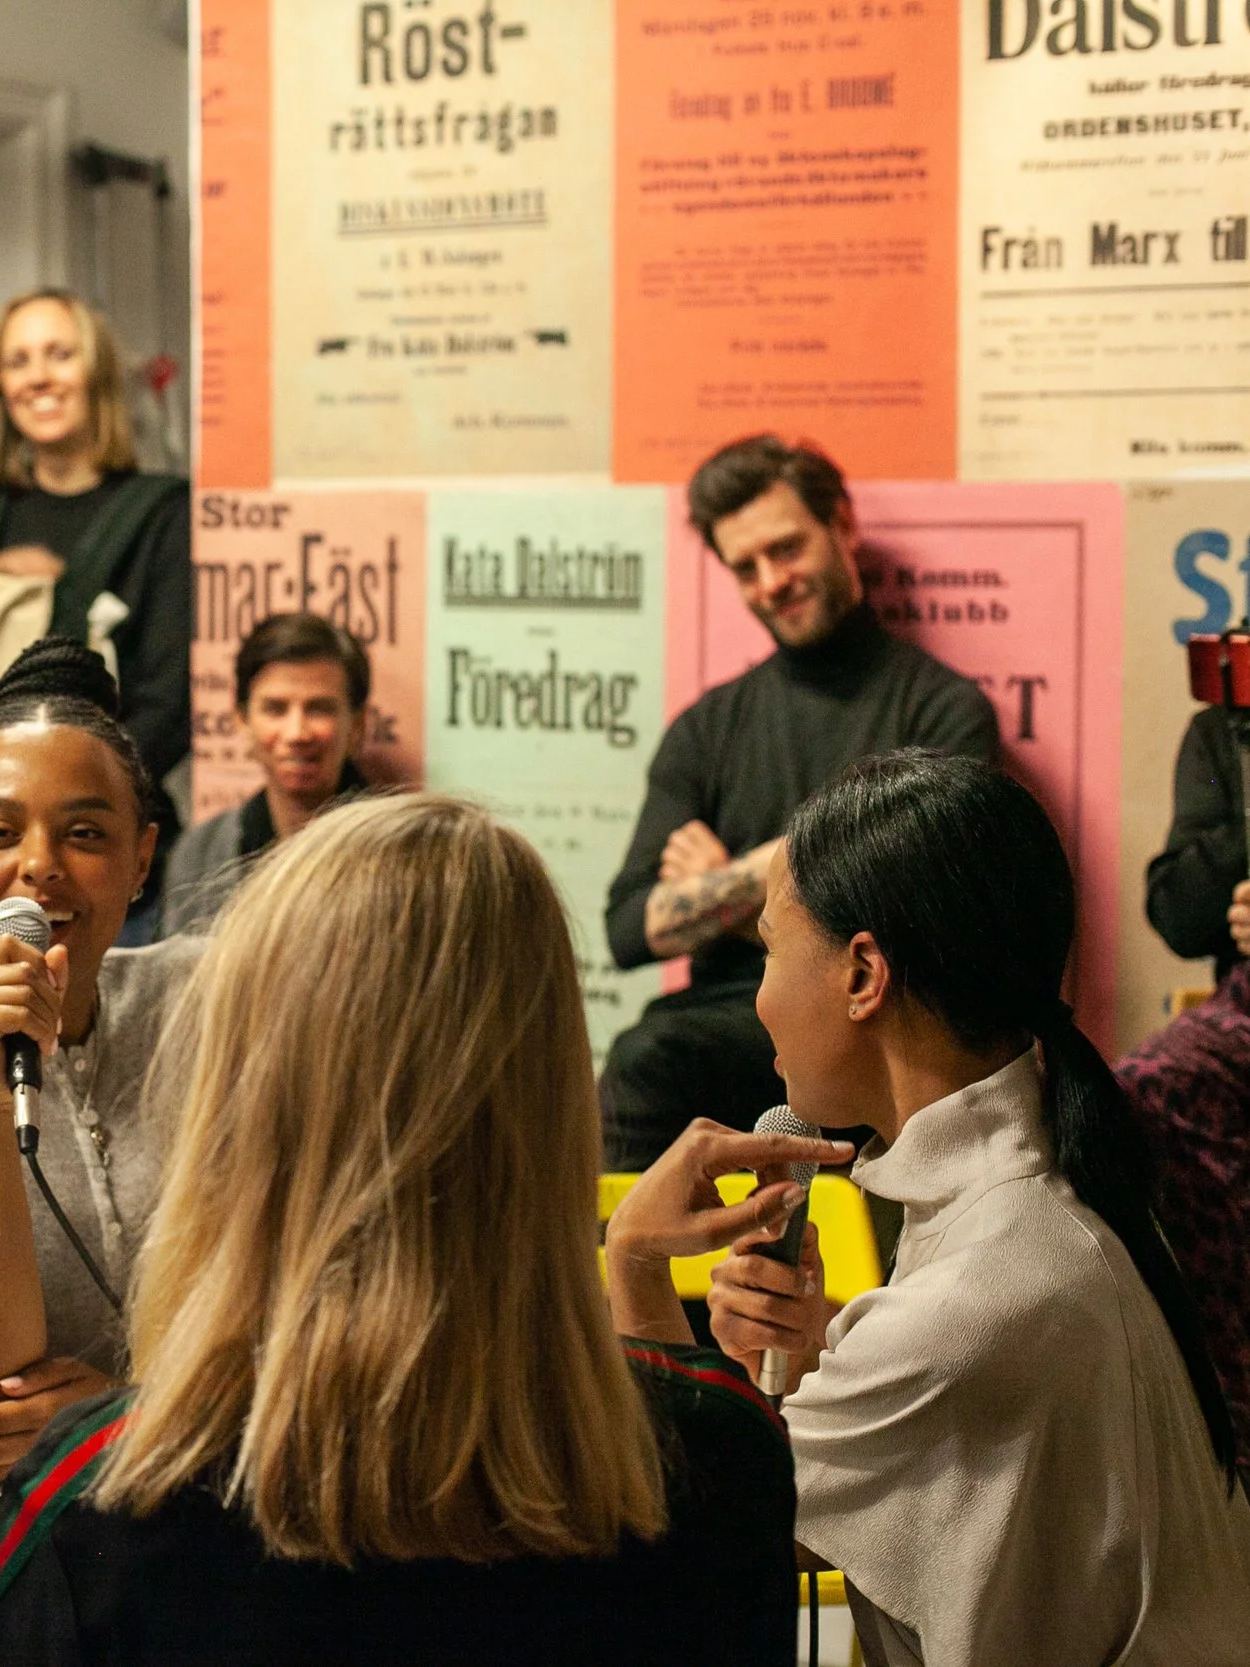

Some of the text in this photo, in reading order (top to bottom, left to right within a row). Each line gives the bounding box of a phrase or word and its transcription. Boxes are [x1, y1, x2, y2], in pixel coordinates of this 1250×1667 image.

[359, 0, 527, 86] Röst-
[984, 0, 1250, 60] Dalstr
[329, 101, 557, 153] rättsfrågan
[1043, 107, 1250, 139] ORDENSHUSET,
[982, 214, 1249, 272] Från Marx till
[201, 496, 291, 529] Stor
[445, 536, 503, 598] Kata
[896, 565, 1009, 589] Komm.
[881, 598, 1009, 624] sklubb
[446, 647, 639, 750] Föredrag
